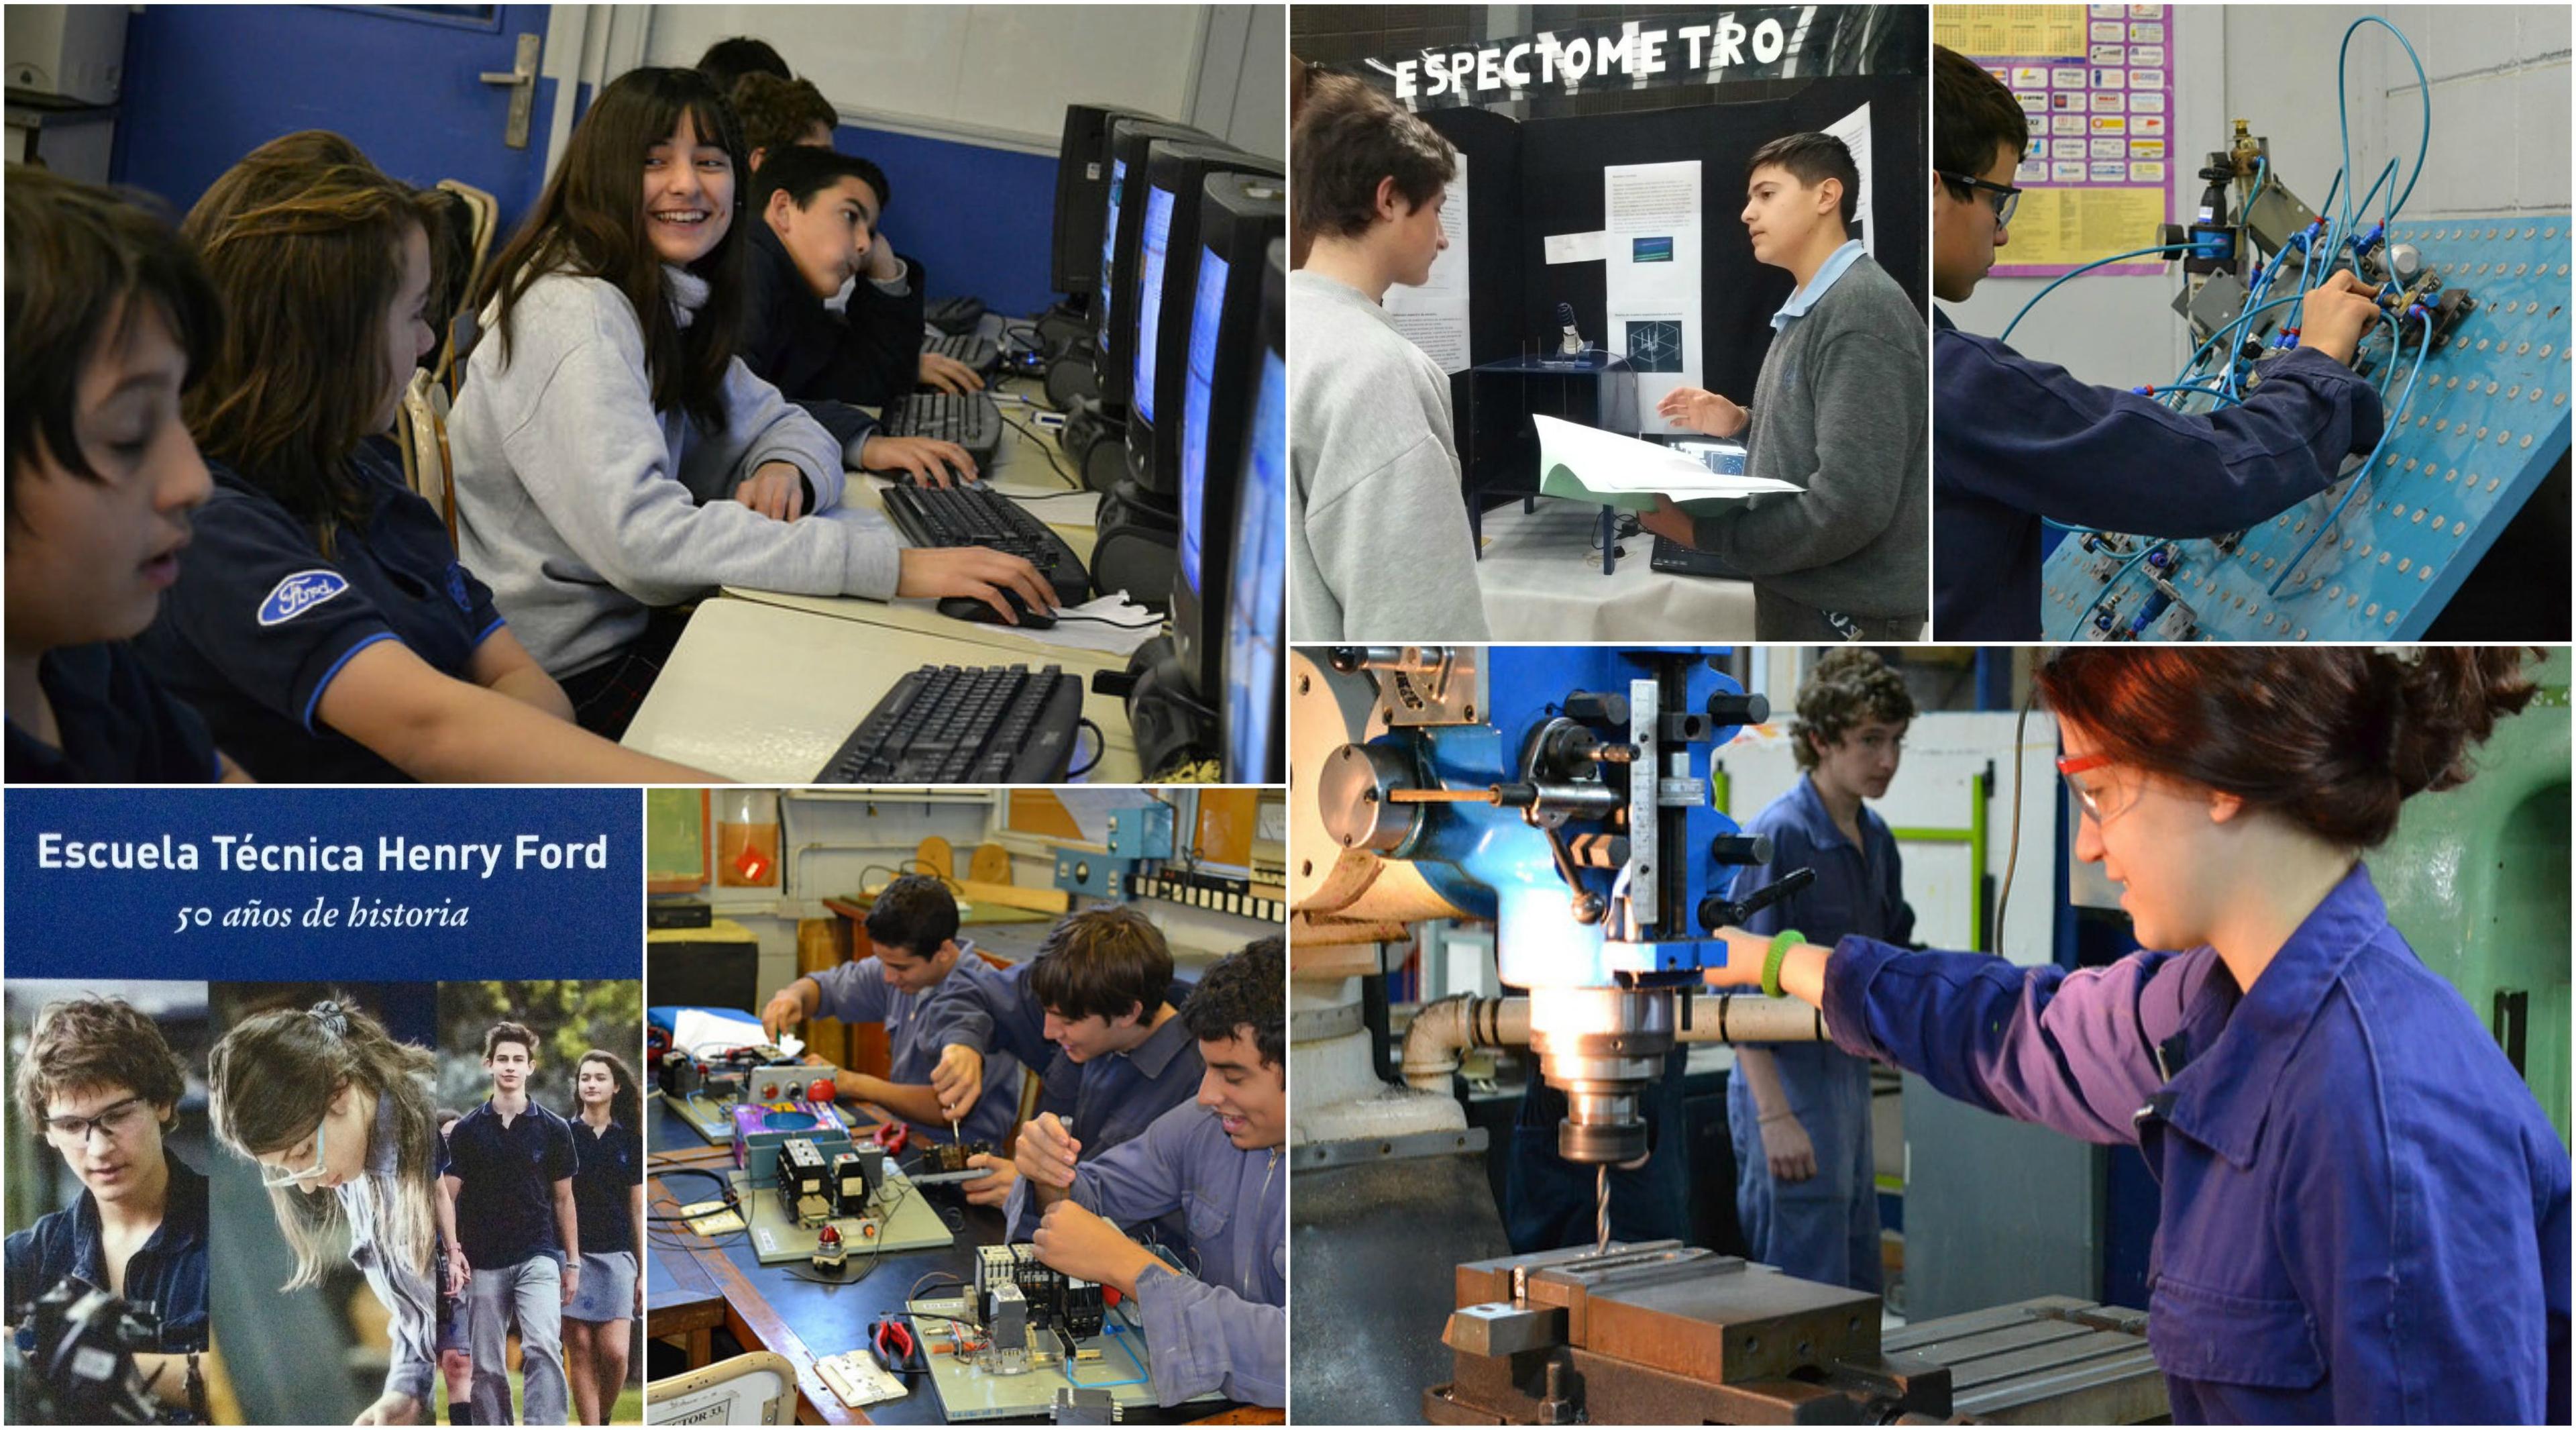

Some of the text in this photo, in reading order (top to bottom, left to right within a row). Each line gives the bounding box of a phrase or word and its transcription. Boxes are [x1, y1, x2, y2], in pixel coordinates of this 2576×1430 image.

[1395, 18, 1784, 99] ESPECTOMETRO
[279, 577, 333, 614] Ford
[39, 833, 607, 879] Escuela Técnica Henry Ford
[174, 896, 469, 933] 50 años de historia
